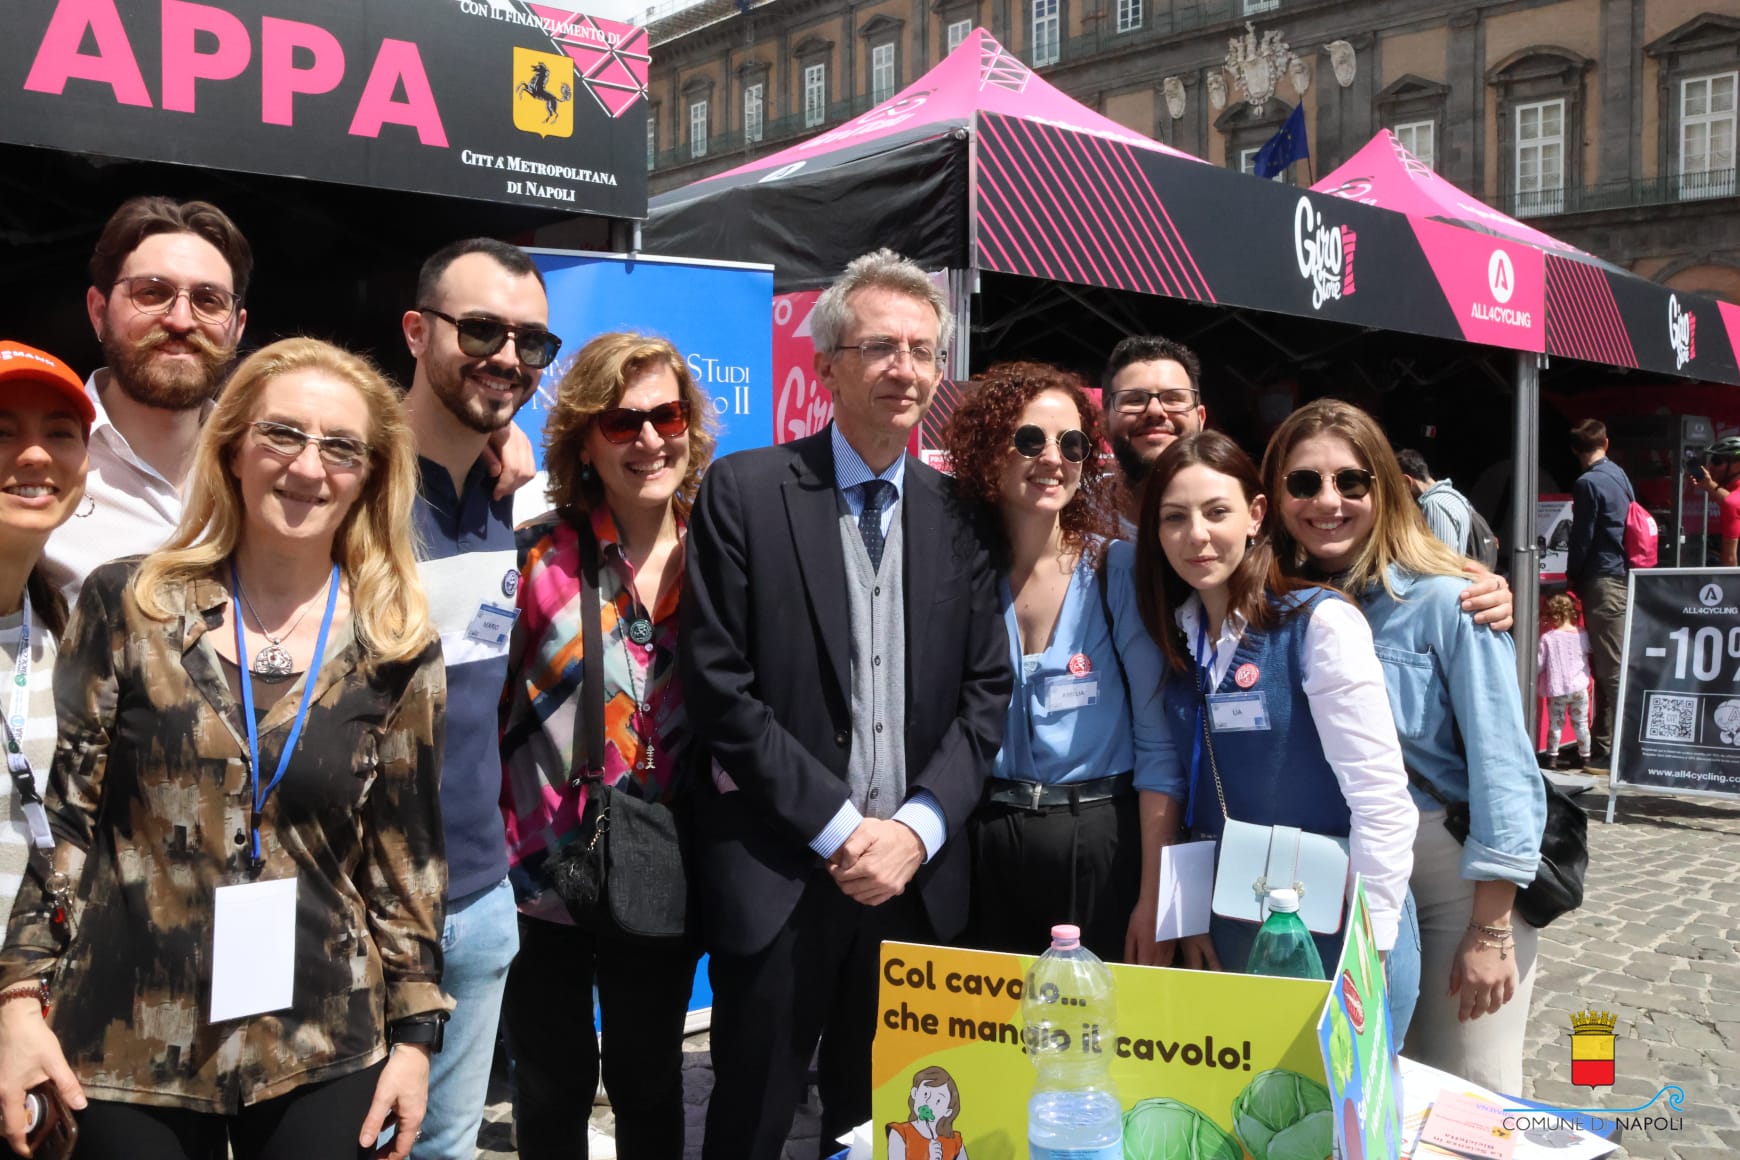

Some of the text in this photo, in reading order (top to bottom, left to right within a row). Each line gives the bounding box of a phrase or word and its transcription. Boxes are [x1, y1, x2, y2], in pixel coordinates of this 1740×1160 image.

[460, 0, 621, 45] CON IL FINANZIAMENTO DI
[23, 0, 450, 148] APPA
[506, 155, 617, 186] METROPOLITANA
[525, 181, 576, 202] NAPOLI
[1294, 195, 1343, 279] Giro
[1312, 265, 1342, 310] Store
[1471, 302, 1531, 328] ALL4CYCLING
[687, 353, 750, 384] STUDI
[734, 386, 749, 415] II
[776, 365, 834, 443] Gir
[1682, 607, 1739, 615] ALL4CYCLING
[883, 958, 936, 991] Col
[883, 1001, 939, 1036] che
[1115, 1035, 1252, 1072] cavolo!
